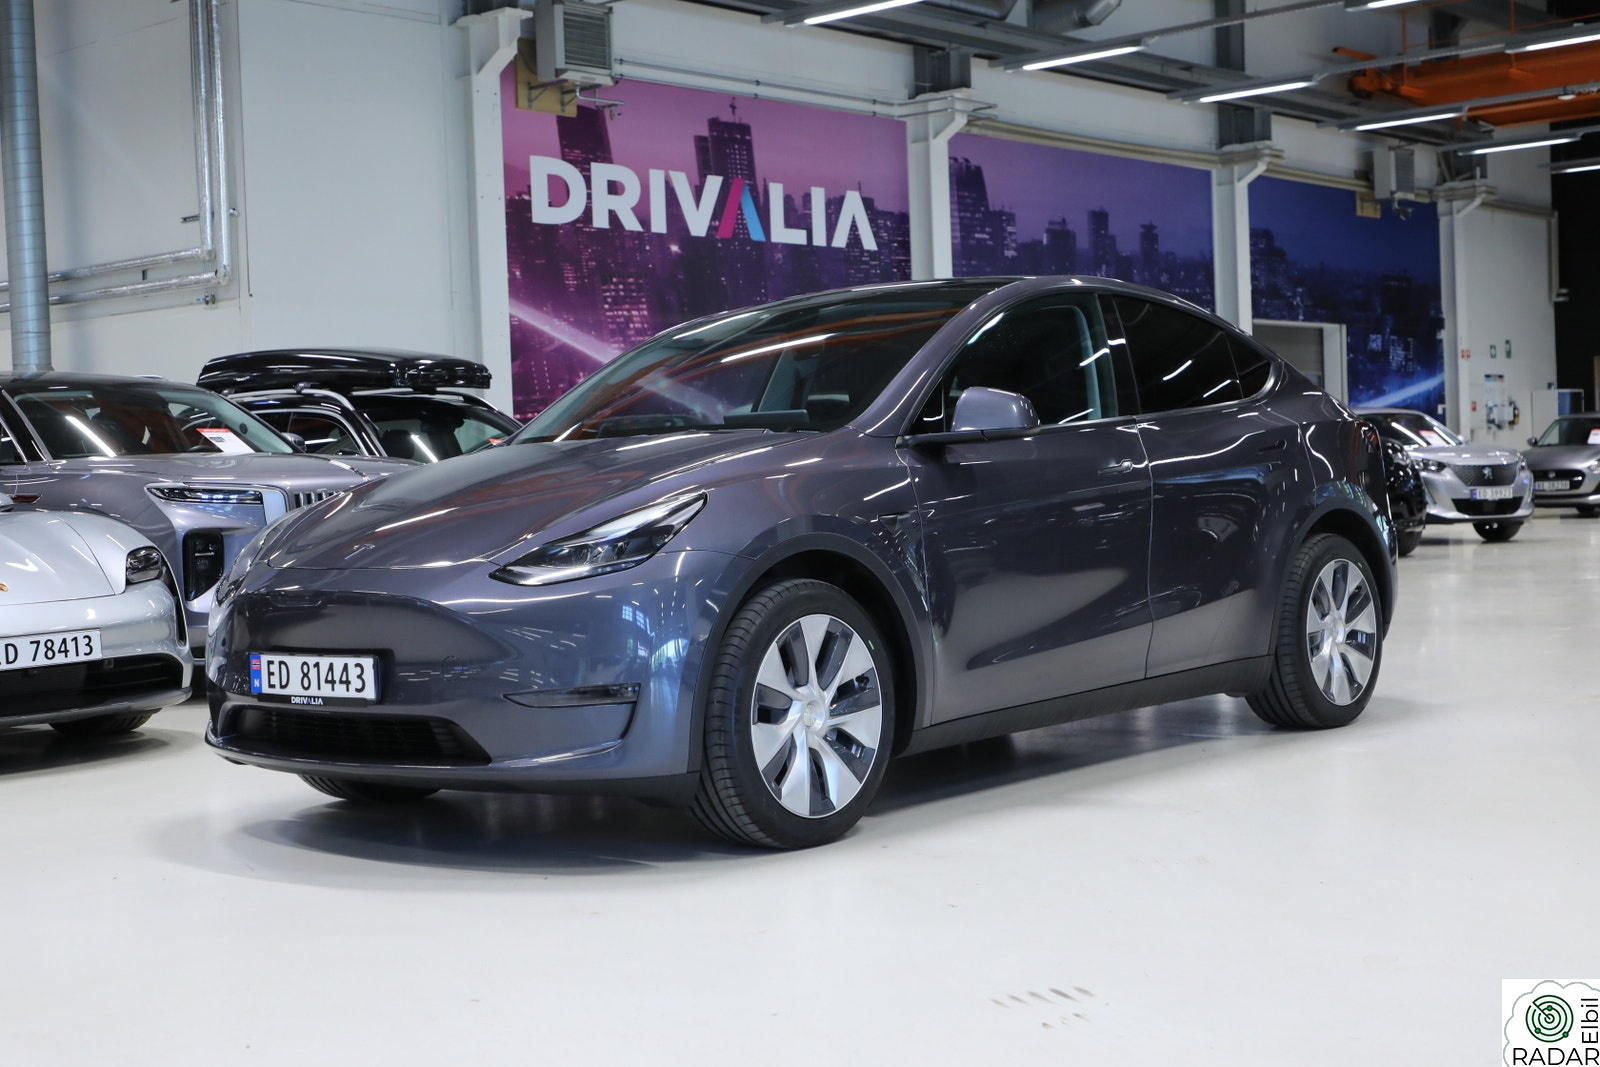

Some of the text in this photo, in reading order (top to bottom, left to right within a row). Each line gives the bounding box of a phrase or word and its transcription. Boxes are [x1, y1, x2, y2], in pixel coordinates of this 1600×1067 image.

[529, 155, 878, 250] DRIVALIA
[0, 635, 93, 665] D 78413
[254, 679, 260, 688] N
[266, 660, 366, 693] ED 81443
[291, 696, 324, 705] DRIVALIA
